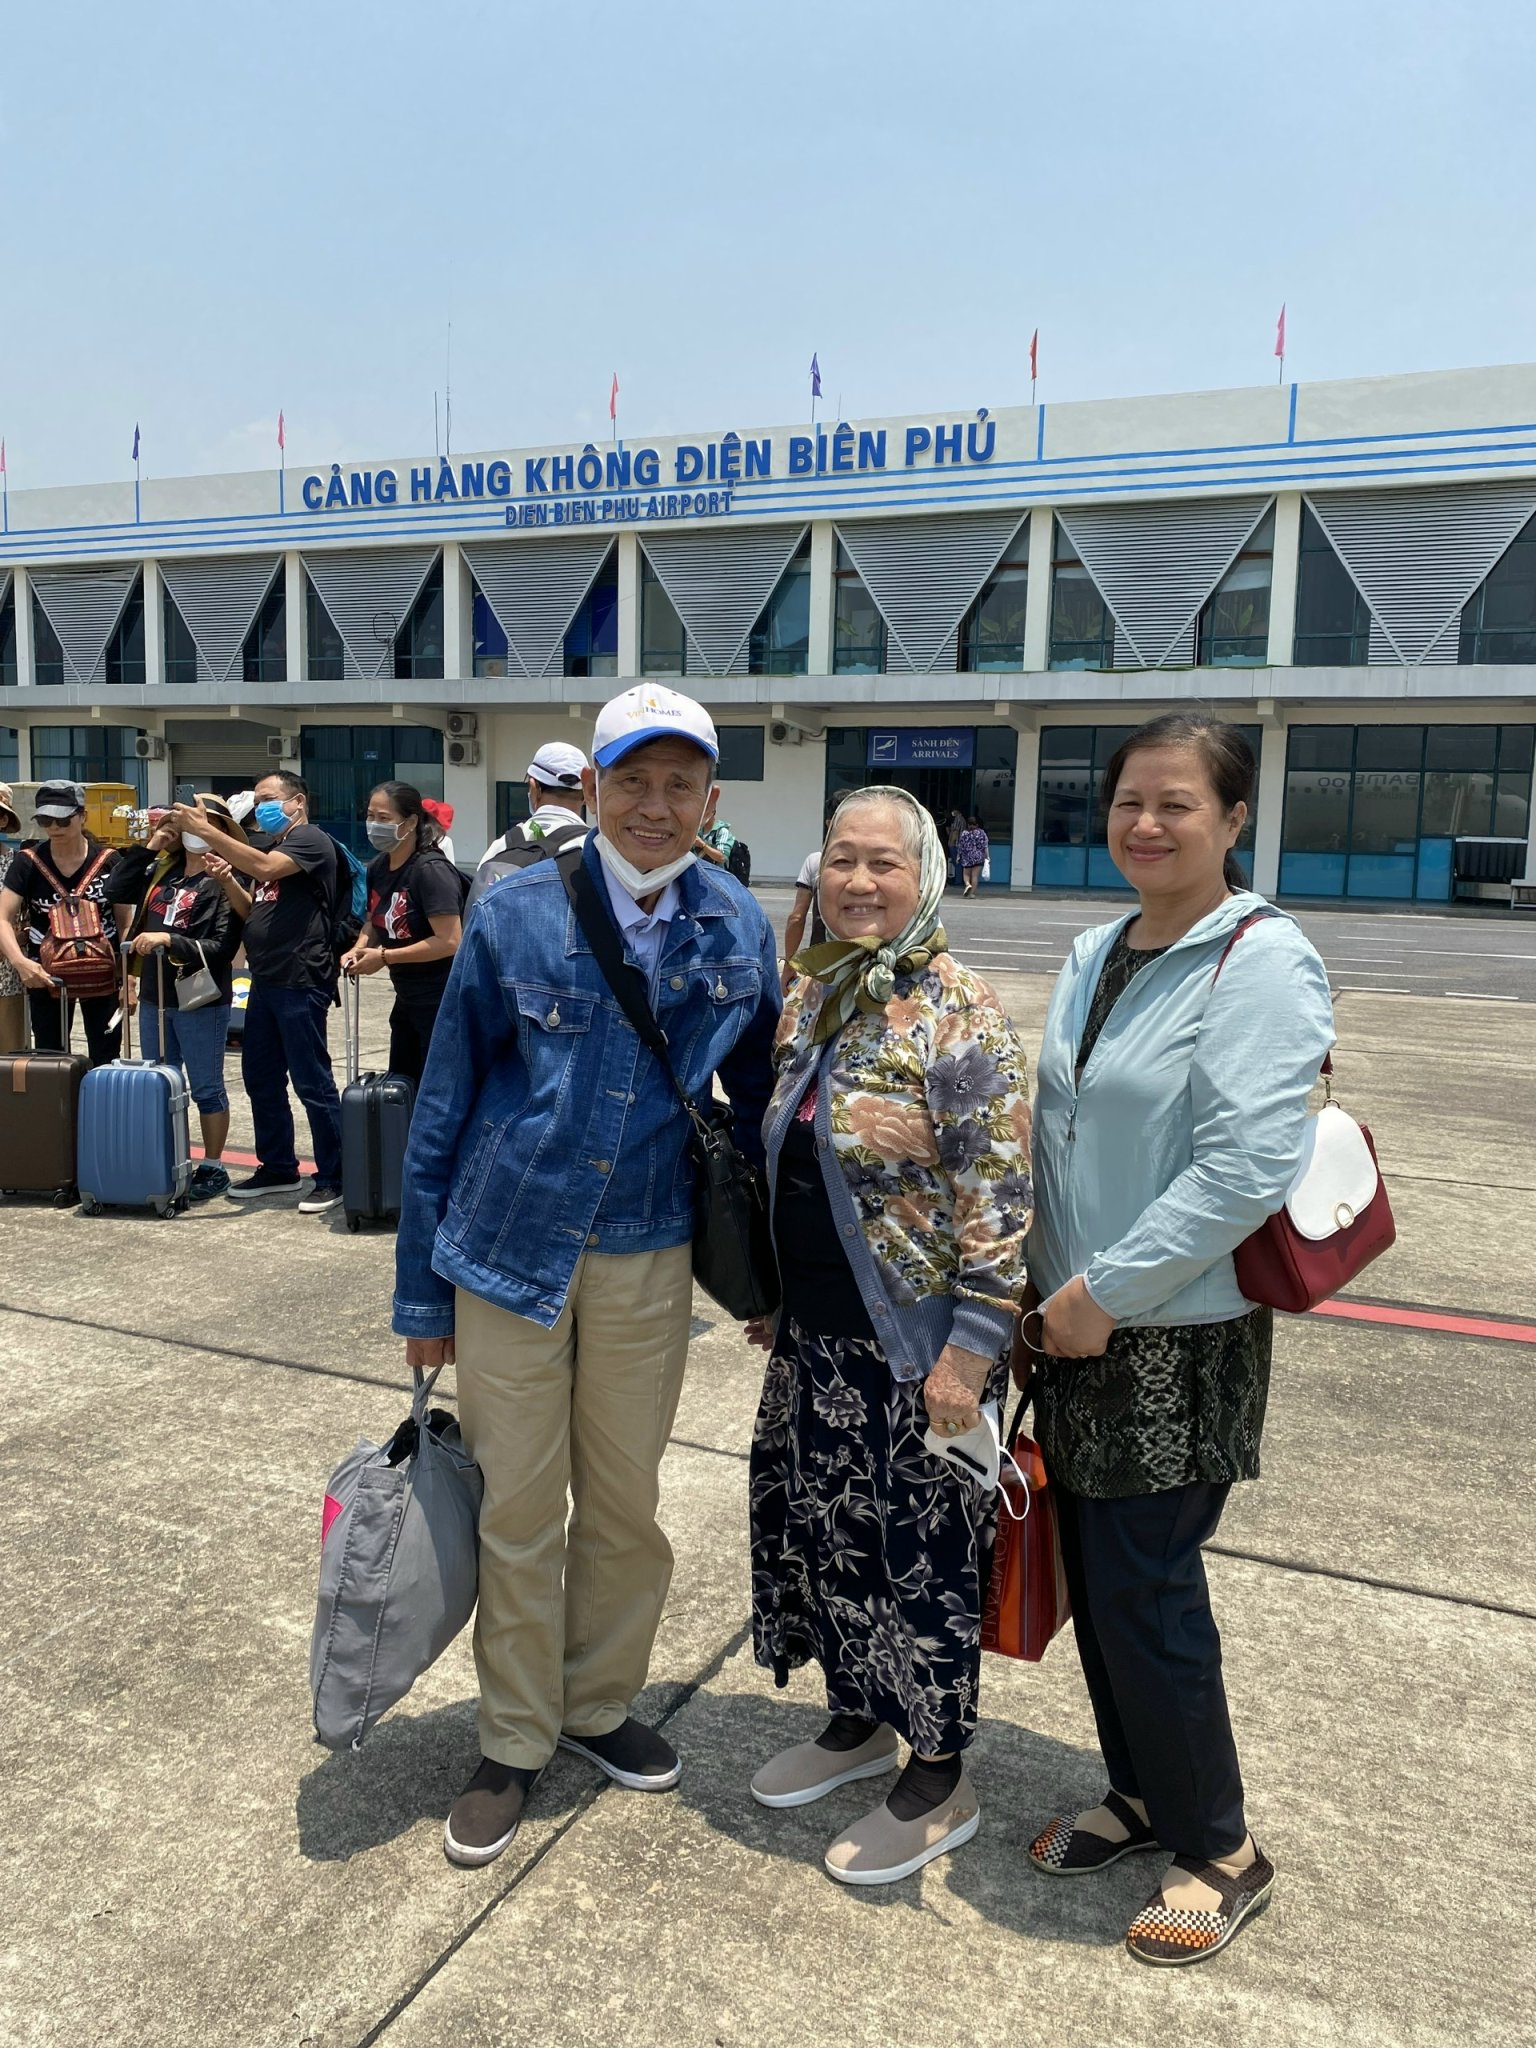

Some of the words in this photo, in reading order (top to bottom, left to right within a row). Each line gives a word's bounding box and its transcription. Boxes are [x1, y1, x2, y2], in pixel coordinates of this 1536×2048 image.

[302, 463, 398, 510] CẢNG
[410, 456, 512, 502] HÀNG
[525, 443, 661, 493] KHÔNG
[674, 431, 772, 488] ĐIỆN
[788, 422, 887, 474] BIÊN
[904, 408, 997, 466] PHỦ
[505, 503, 549, 527] DIEN
[553, 499, 596, 524] BIEN
[601, 496, 641, 521] PHU
[646, 491, 734, 518] AIRPORT
[911, 750, 959, 758] ARRIVALS
